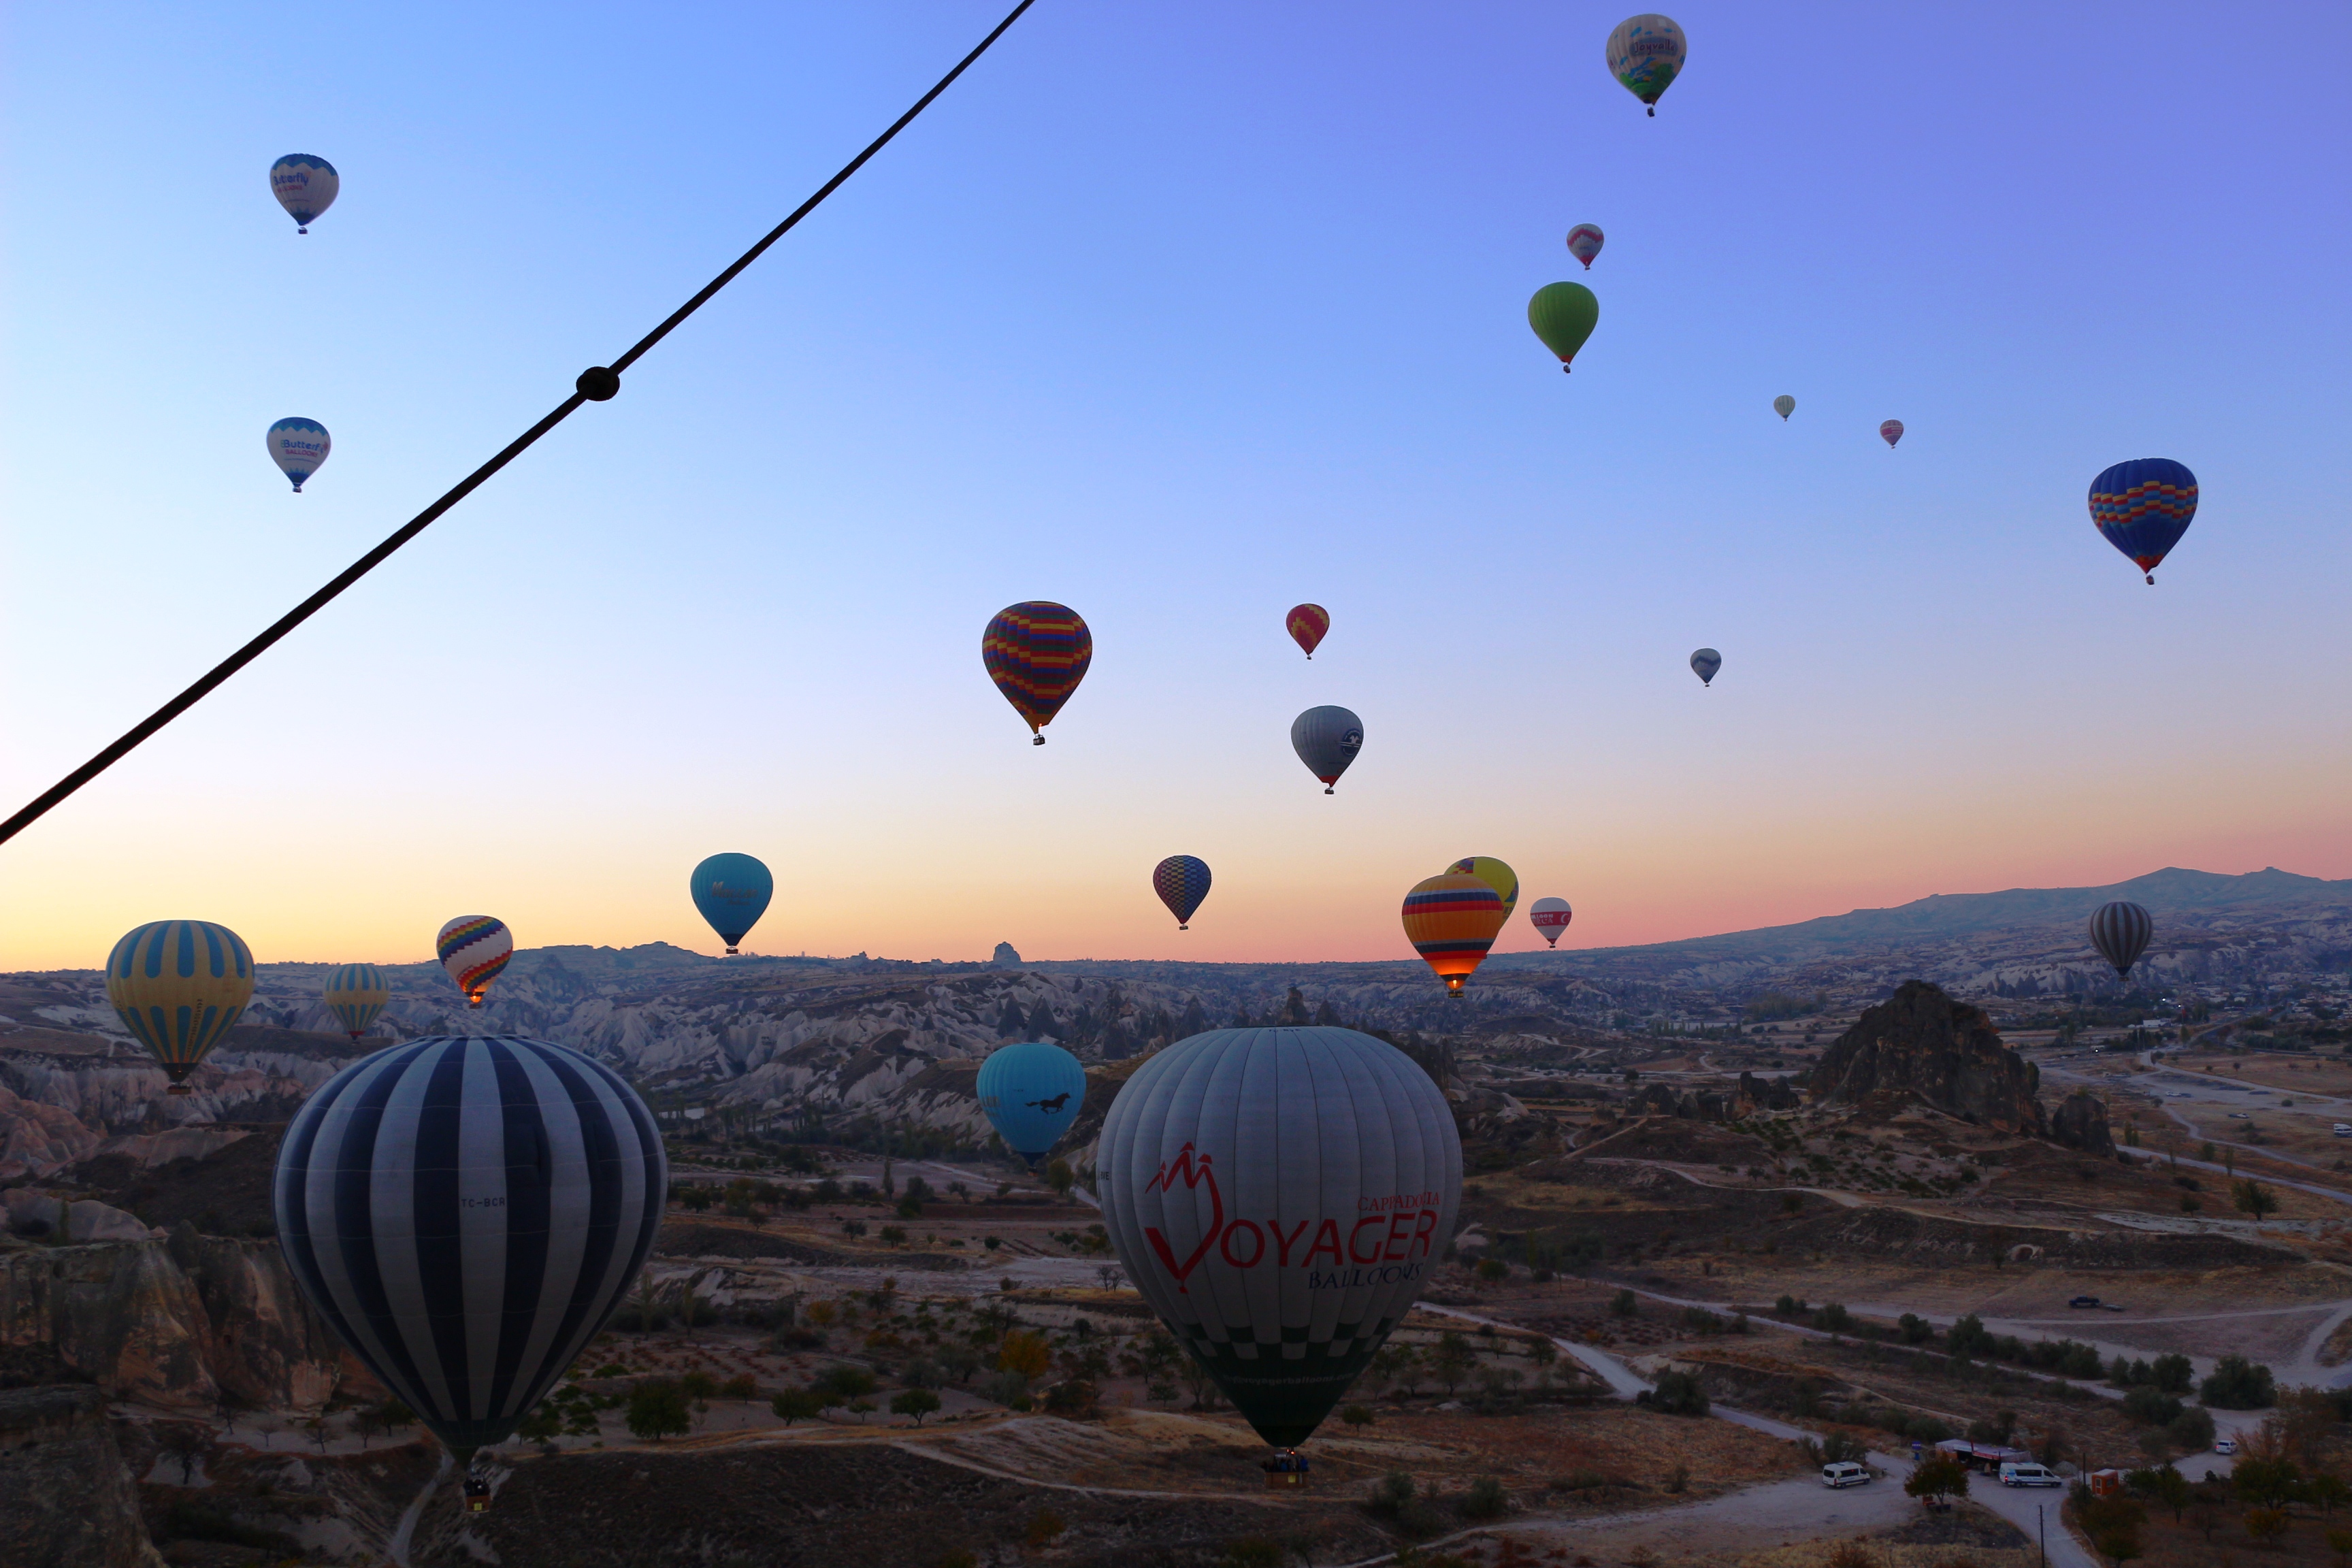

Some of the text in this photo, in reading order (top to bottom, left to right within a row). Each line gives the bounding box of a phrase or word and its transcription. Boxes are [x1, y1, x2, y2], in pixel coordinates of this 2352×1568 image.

[461, 1196, 506, 1208] TC-BCR
[1358, 1191, 1441, 1211] CAPPADOCIA
[1145, 1154, 1439, 1286] VOYAGER
[1307, 1262, 1424, 1290] BALLOONS
